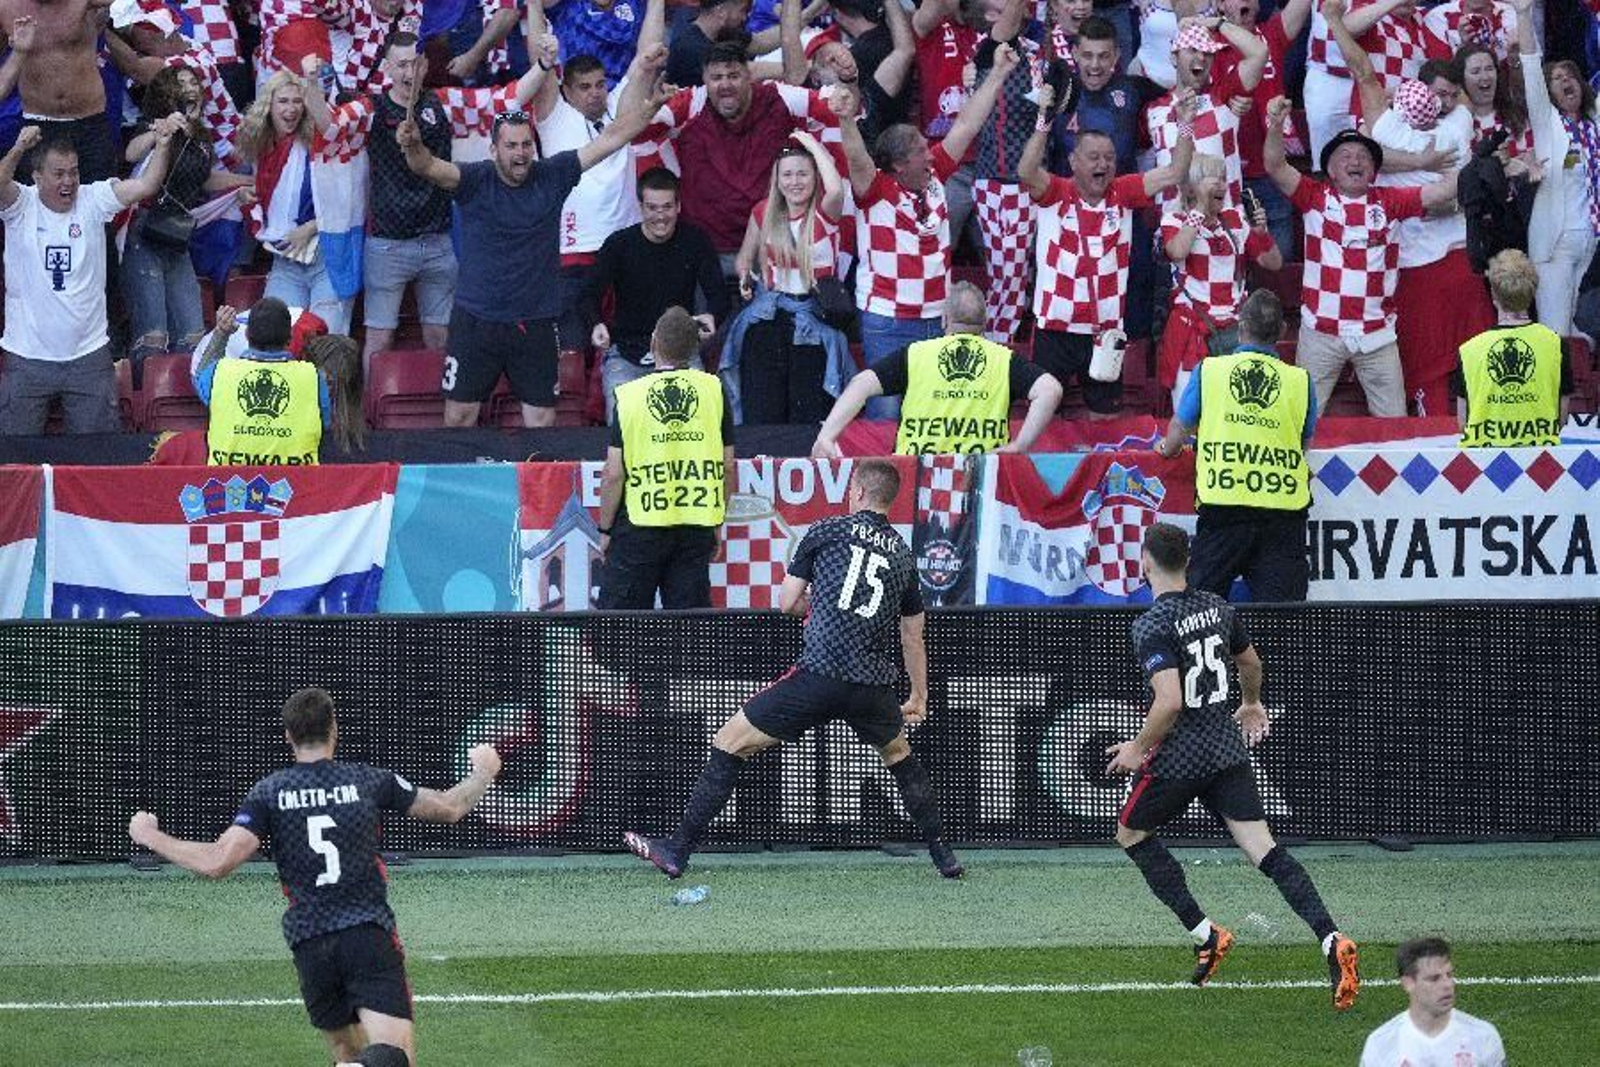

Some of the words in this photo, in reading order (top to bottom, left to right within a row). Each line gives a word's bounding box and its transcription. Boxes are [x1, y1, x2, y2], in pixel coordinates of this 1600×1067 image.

[441, 355, 459, 391] 3
[905, 417, 1007, 440] STEWARD
[1460, 417, 1561, 442] STEWARD
[212, 449, 314, 466] STEWARD
[1202, 441, 1302, 470] STEWARD
[629, 459, 725, 488] STEWARD
[1206, 467, 1299, 495] 06-099
[837, 543, 891, 619] 15
[1184, 633, 1229, 709] 25
[306, 814, 342, 887] 5
